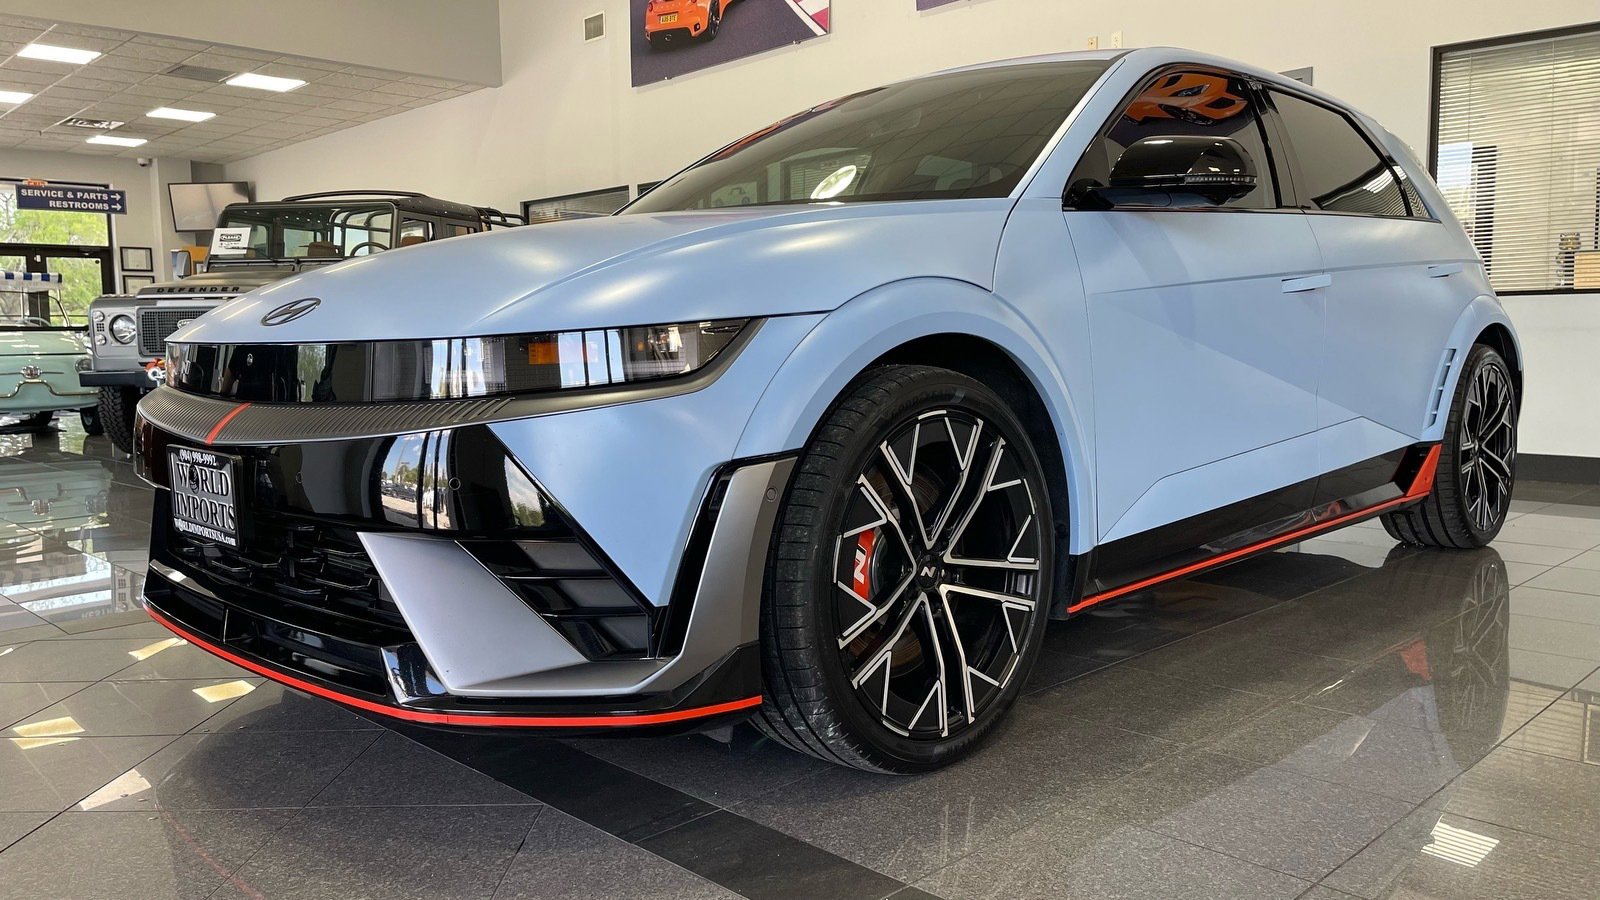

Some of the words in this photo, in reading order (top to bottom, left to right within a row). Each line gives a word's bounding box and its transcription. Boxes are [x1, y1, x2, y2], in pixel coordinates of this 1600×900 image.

[21, 189, 64, 198] SERVICE
[77, 192, 109, 200] PARTS
[49, 201, 109, 210] RESTROOMS
[175, 491, 235, 530] IMPORTS
[920, 566, 936, 578] N
